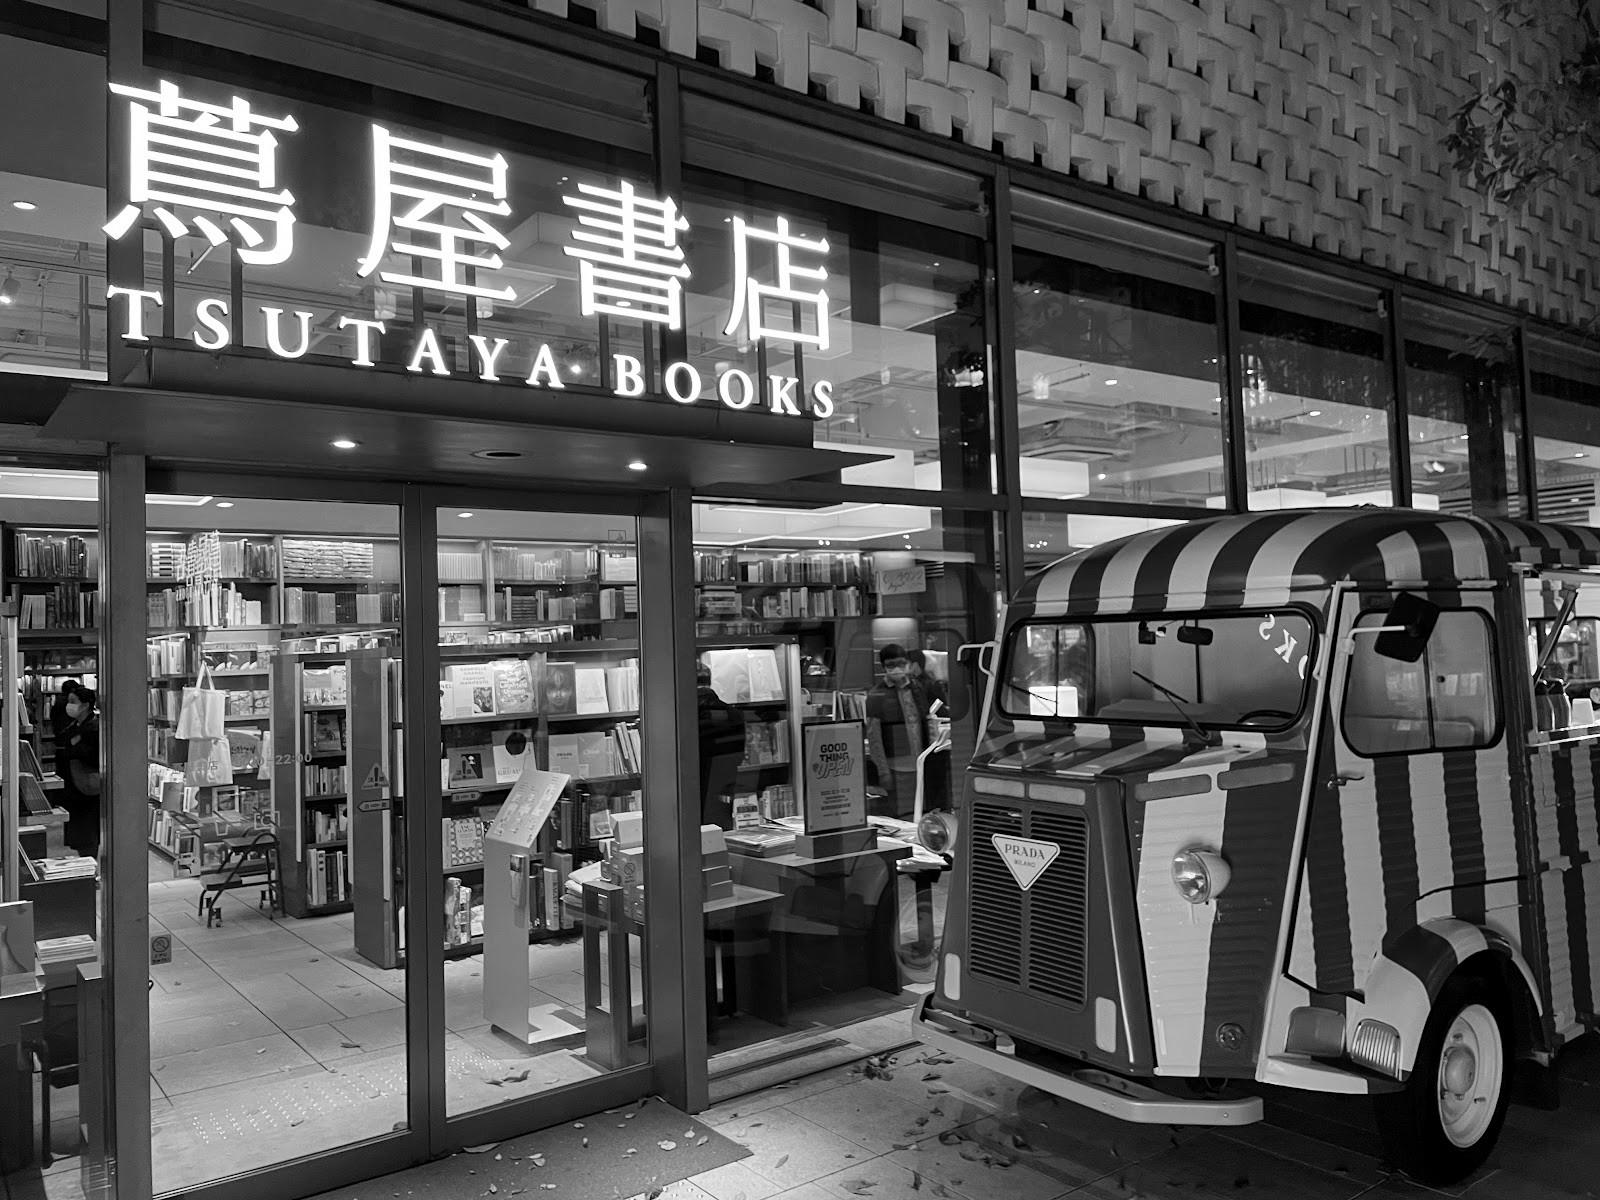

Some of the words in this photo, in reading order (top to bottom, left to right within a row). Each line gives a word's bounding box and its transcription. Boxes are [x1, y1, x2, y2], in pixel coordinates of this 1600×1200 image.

[101, 79, 832, 351] 蔦屋書店
[106, 283, 566, 389] TSUTAYA
[612, 353, 835, 419] BOOKS
[820, 743, 848, 754] GOOD
[275, 752, 313, 766] 22:00
[819, 752, 850, 763] THING
[1004, 843, 1045, 860] PRADA
[1013, 859, 1036, 868] MILANO
